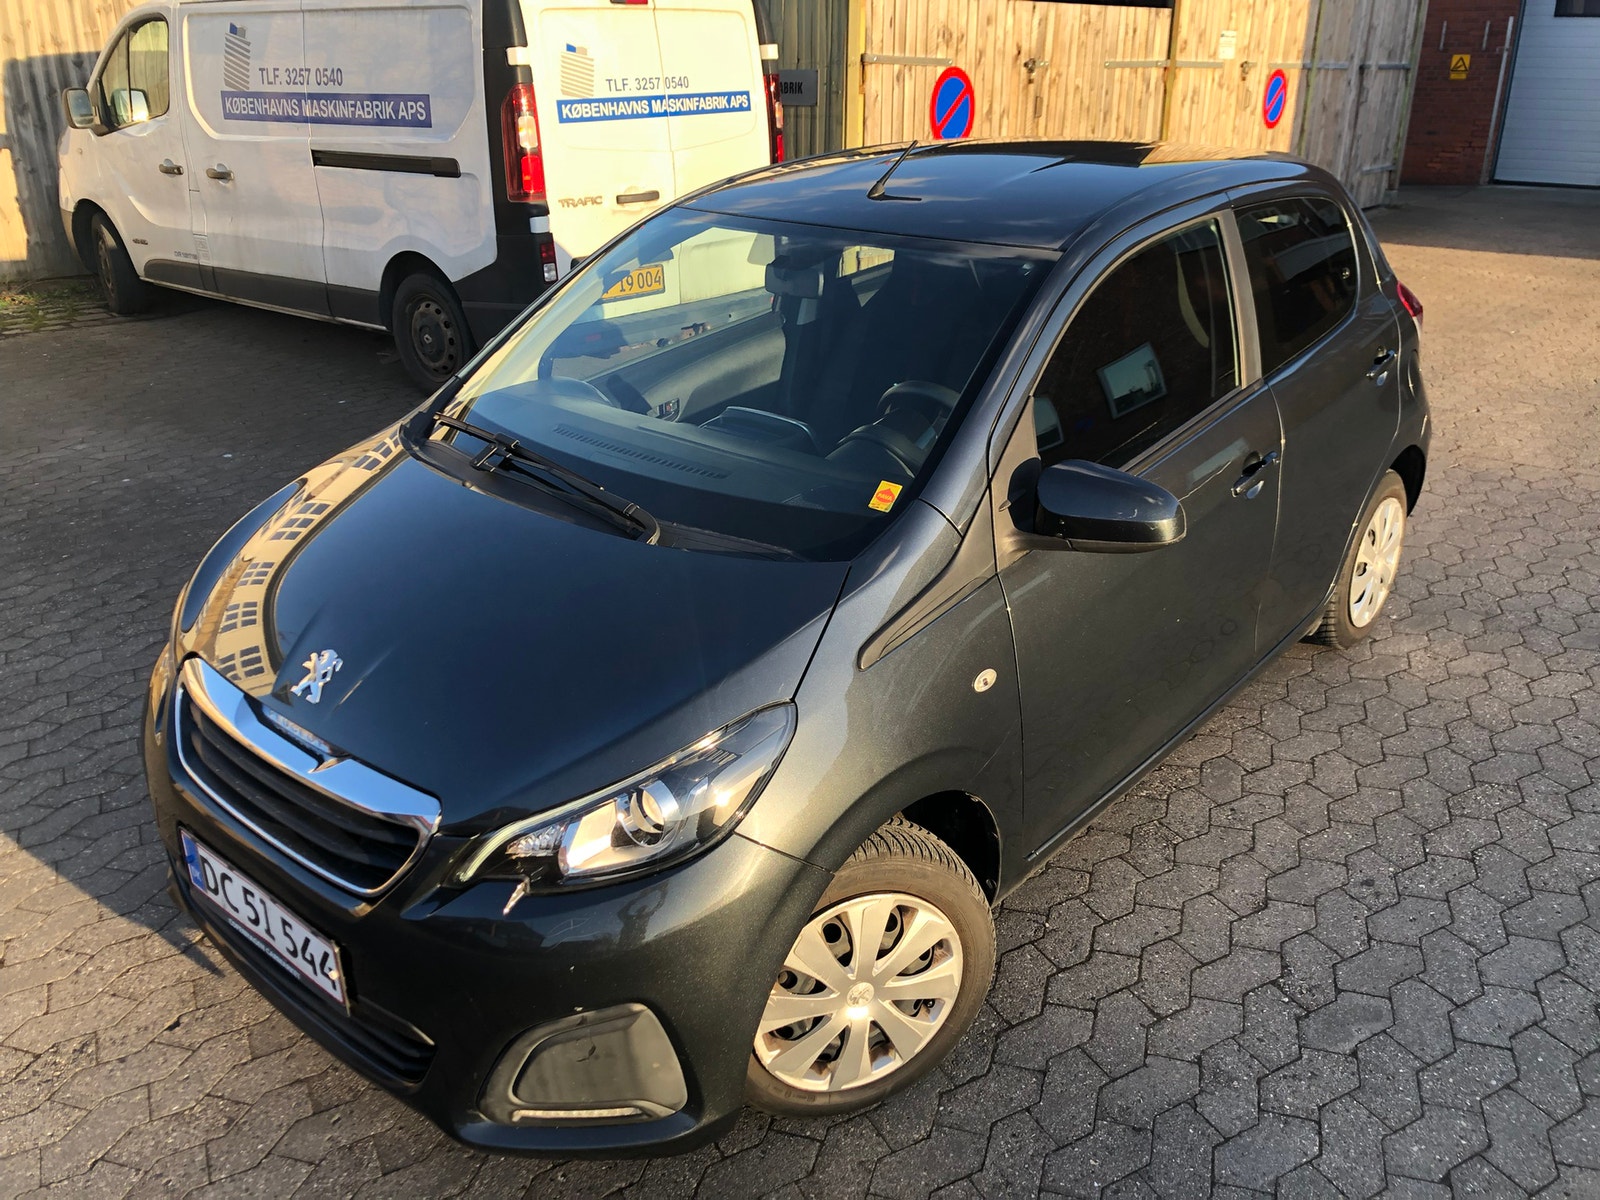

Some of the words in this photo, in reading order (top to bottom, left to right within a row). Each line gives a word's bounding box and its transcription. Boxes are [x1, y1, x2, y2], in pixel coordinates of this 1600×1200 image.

[258, 67, 282, 85] TLF.
[285, 68, 311, 86] 3257
[315, 67, 343, 87] 0540
[605, 77, 632, 92] TLF.
[635, 77, 661, 91] 3257
[664, 76, 689, 90] 0540
[224, 96, 299, 117] KØBENHAVNS
[301, 98, 395, 120] MASKINFABRIK
[398, 101, 426, 121] APS
[561, 100, 649, 119] KØBENHAVNS
[651, 95, 729, 114] MASKINFABRIK
[730, 94, 748, 109] APS
[558, 195, 603, 208] TRAFIC
[619, 274, 634, 292] 19
[637, 269, 661, 289] 004
[200, 856, 239, 914] DC
[242, 886, 275, 941] 51
[280, 916, 338, 991] 544
